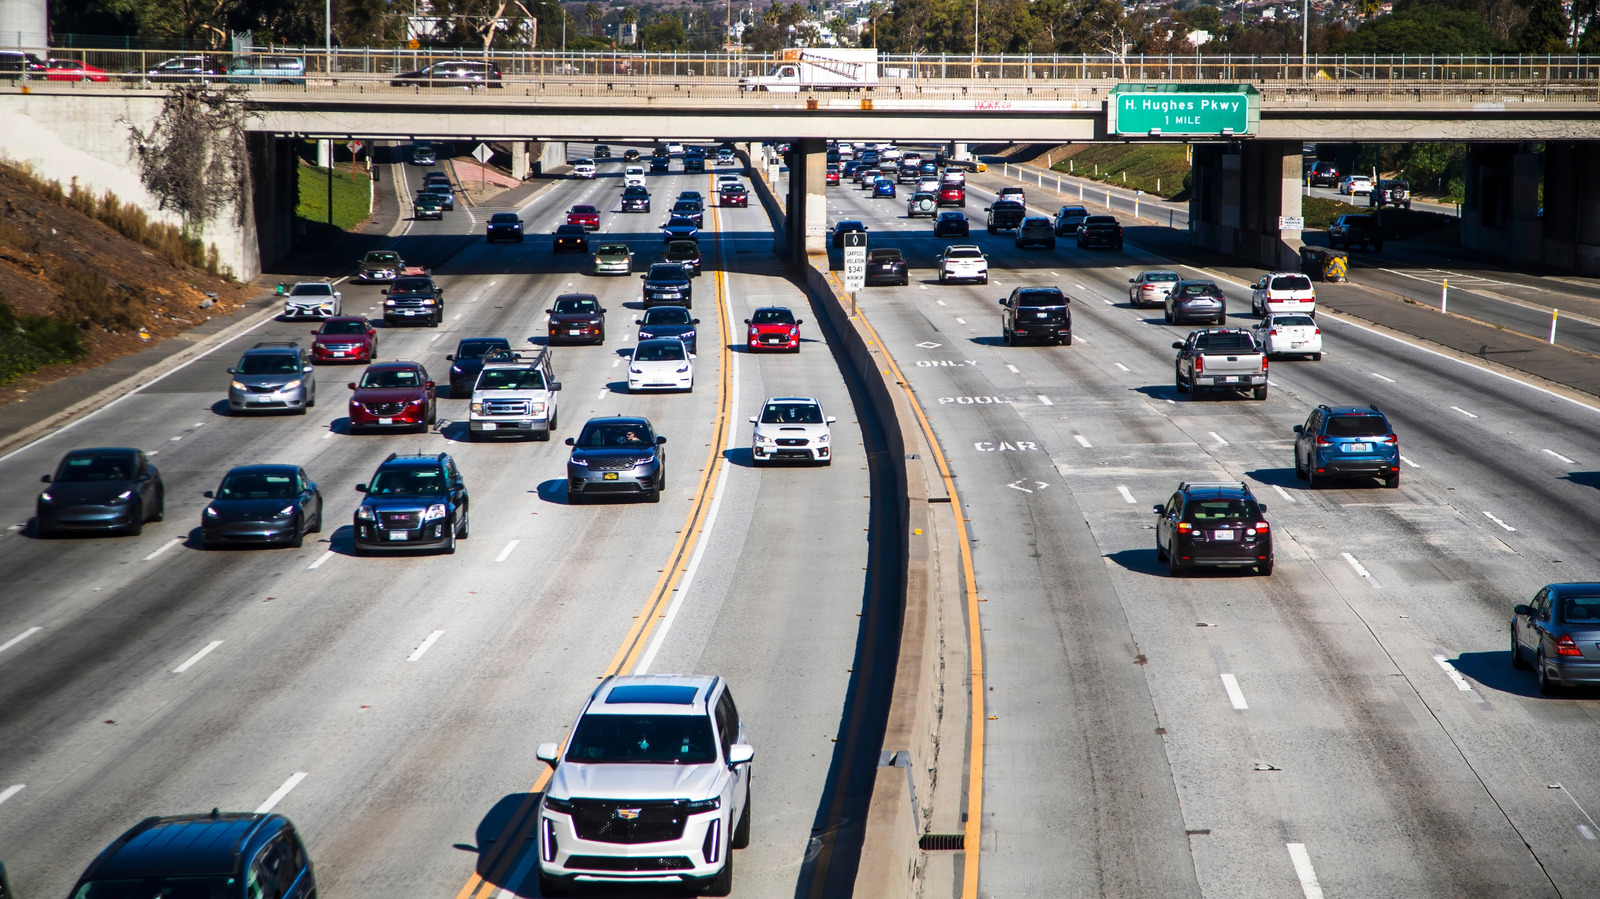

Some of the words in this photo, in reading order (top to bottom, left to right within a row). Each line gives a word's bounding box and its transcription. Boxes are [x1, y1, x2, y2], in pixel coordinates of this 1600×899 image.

[1125, 99, 1137, 110] H.
[1142, 99, 1194, 113] Hughes
[1201, 99, 1240, 112] Pkwy
[1165, 115, 1169, 125] 1
[1175, 116, 1201, 125] MILE
[848, 265, 862, 273] $341
[938, 396, 1012, 405] POOL
[974, 441, 1039, 452] CAR
